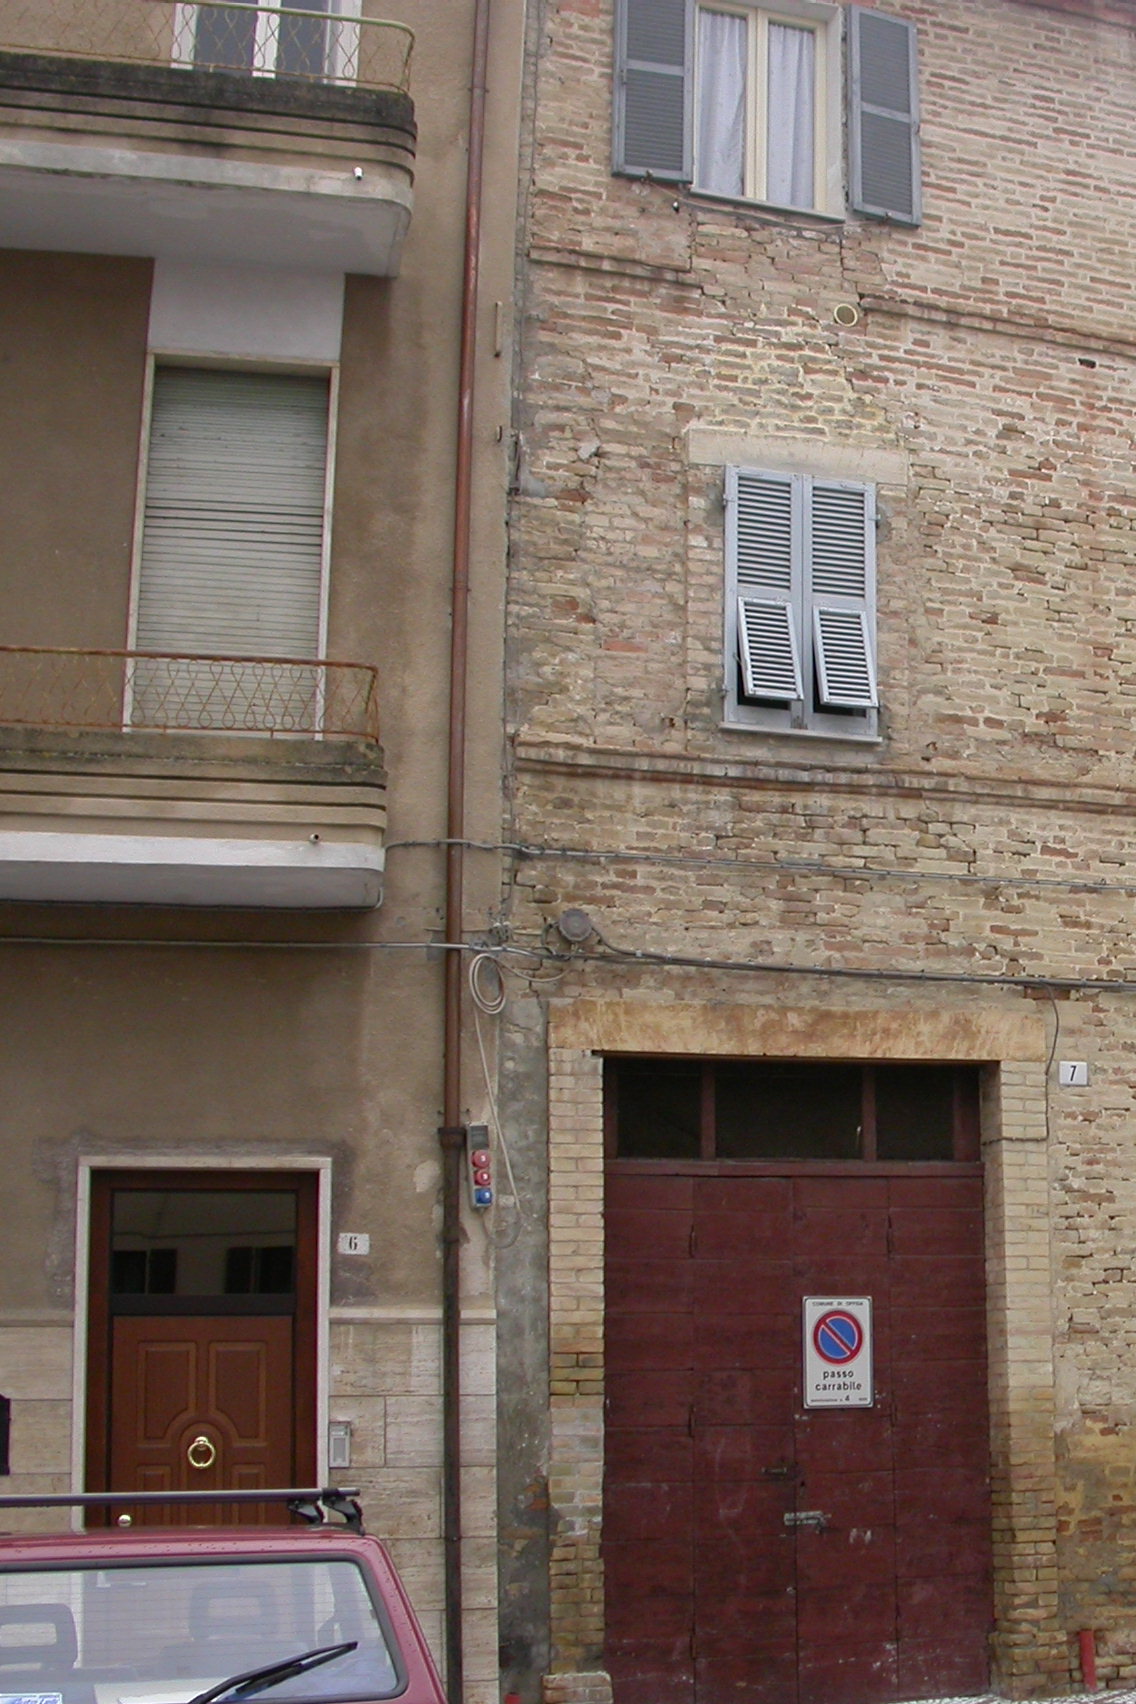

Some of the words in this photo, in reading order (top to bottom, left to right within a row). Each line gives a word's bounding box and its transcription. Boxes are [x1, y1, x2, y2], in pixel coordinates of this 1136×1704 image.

[1070, 1065, 1077, 1082] 7
[349, 1236, 358, 1251] 6
[823, 1370, 854, 1380] passo
[815, 1381, 862, 1391] carrabile
